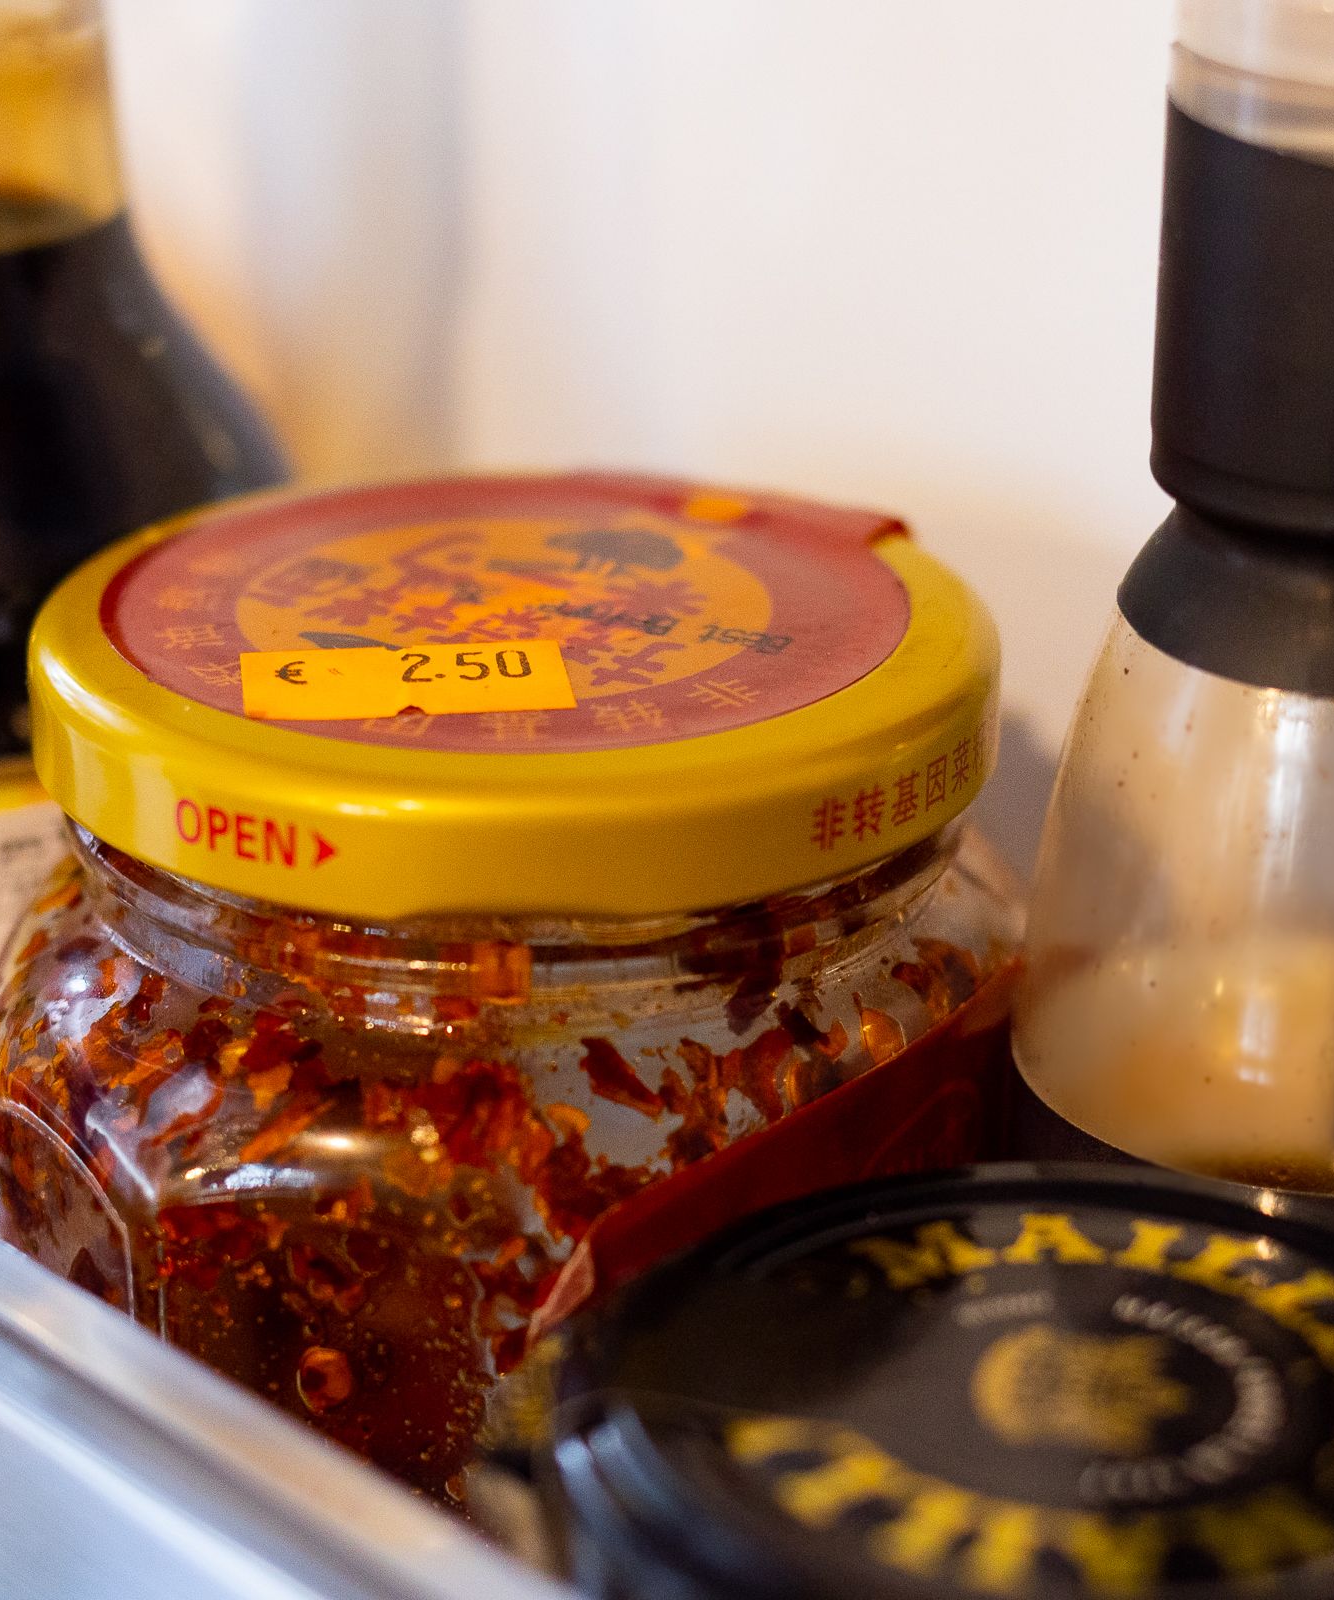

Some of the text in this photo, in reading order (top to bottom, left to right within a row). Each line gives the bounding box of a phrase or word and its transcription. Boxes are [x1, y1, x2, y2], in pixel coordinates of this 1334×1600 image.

[699, 623, 794, 656] Best
[274, 650, 534, 686] € 2.50
[174, 798, 297, 869] OPEN
